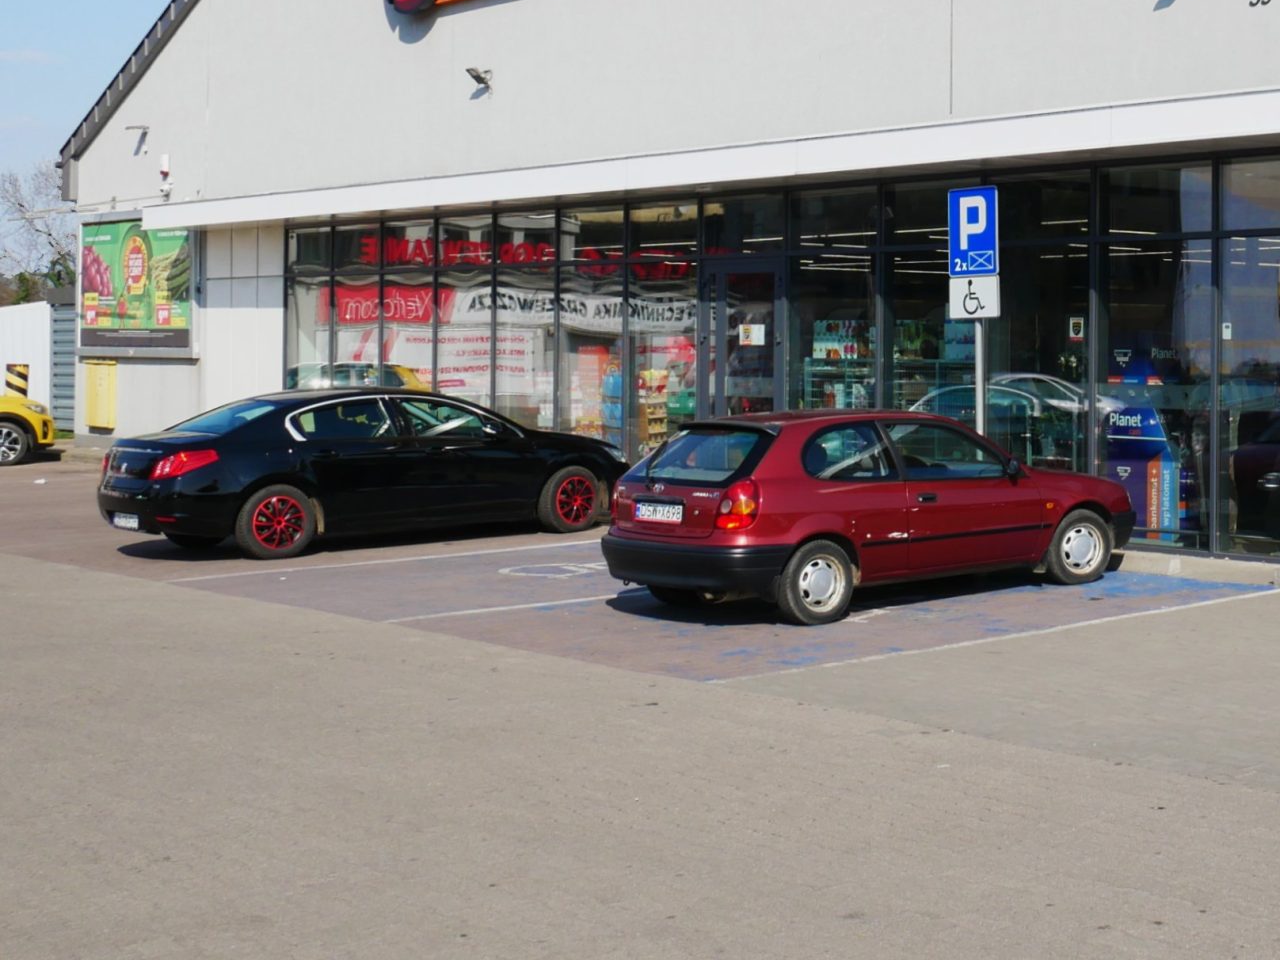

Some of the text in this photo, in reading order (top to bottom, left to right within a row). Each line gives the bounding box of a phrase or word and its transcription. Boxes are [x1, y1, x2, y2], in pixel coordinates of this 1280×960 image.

[959, 195, 987, 251] P
[954, 257, 968, 272] 2x
[1151, 347, 1177, 359] Planet
[1109, 413, 1142, 428] Planet
